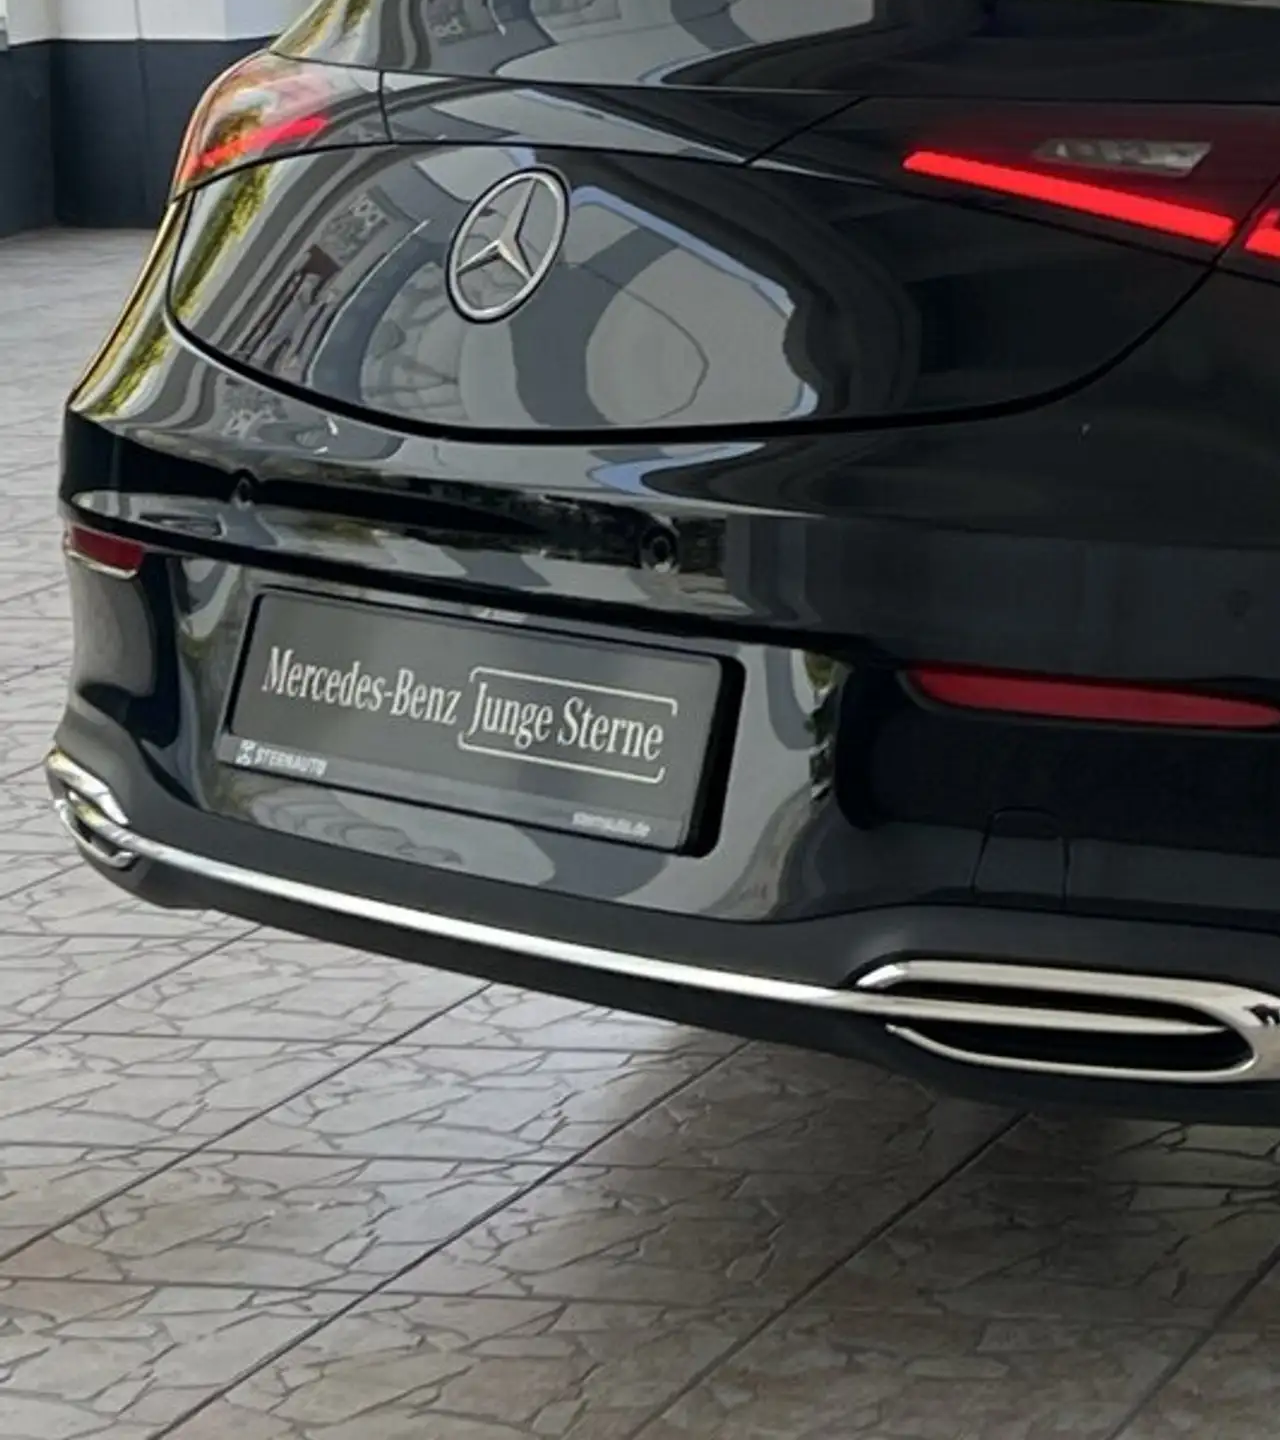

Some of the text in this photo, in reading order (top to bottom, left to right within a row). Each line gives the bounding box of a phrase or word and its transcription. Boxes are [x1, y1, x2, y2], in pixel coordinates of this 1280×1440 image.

[261, 645, 664, 761] Mercedes-Benz Junge Sterne
